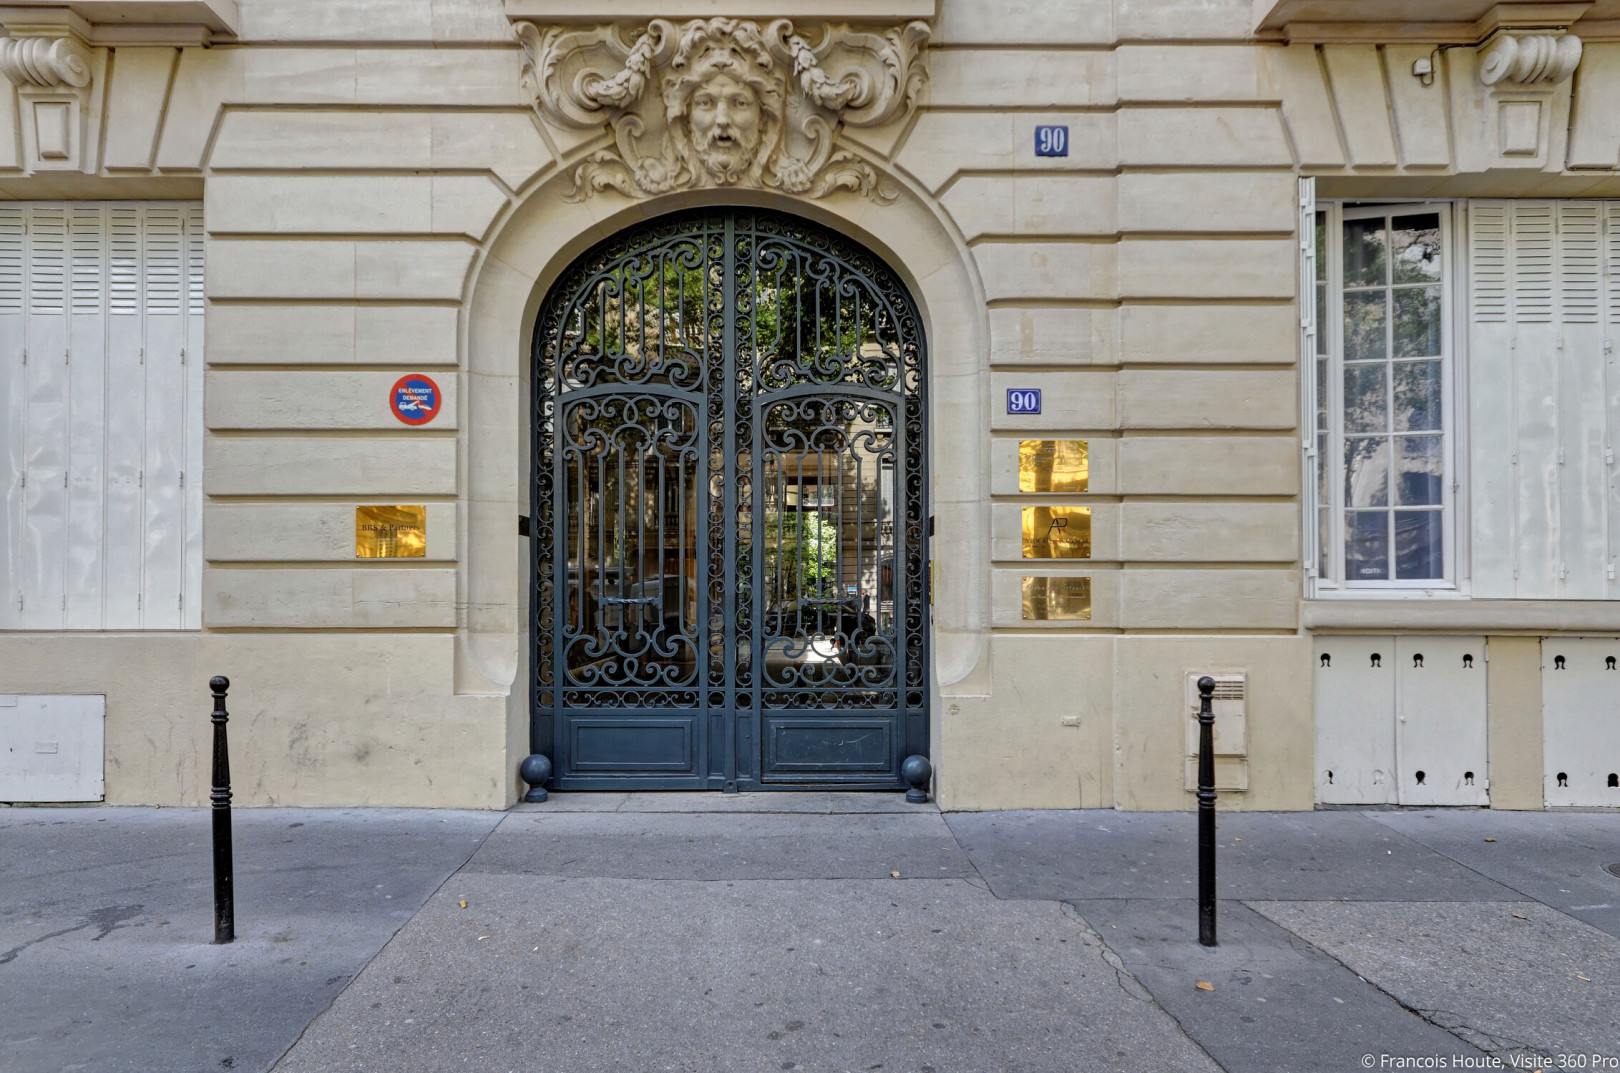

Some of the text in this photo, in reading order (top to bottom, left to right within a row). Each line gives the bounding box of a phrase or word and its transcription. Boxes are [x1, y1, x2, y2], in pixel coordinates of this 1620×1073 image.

[1040, 127, 1065, 152] 90
[1010, 391, 1036, 411] 90
[380, 524, 386, 532] &
